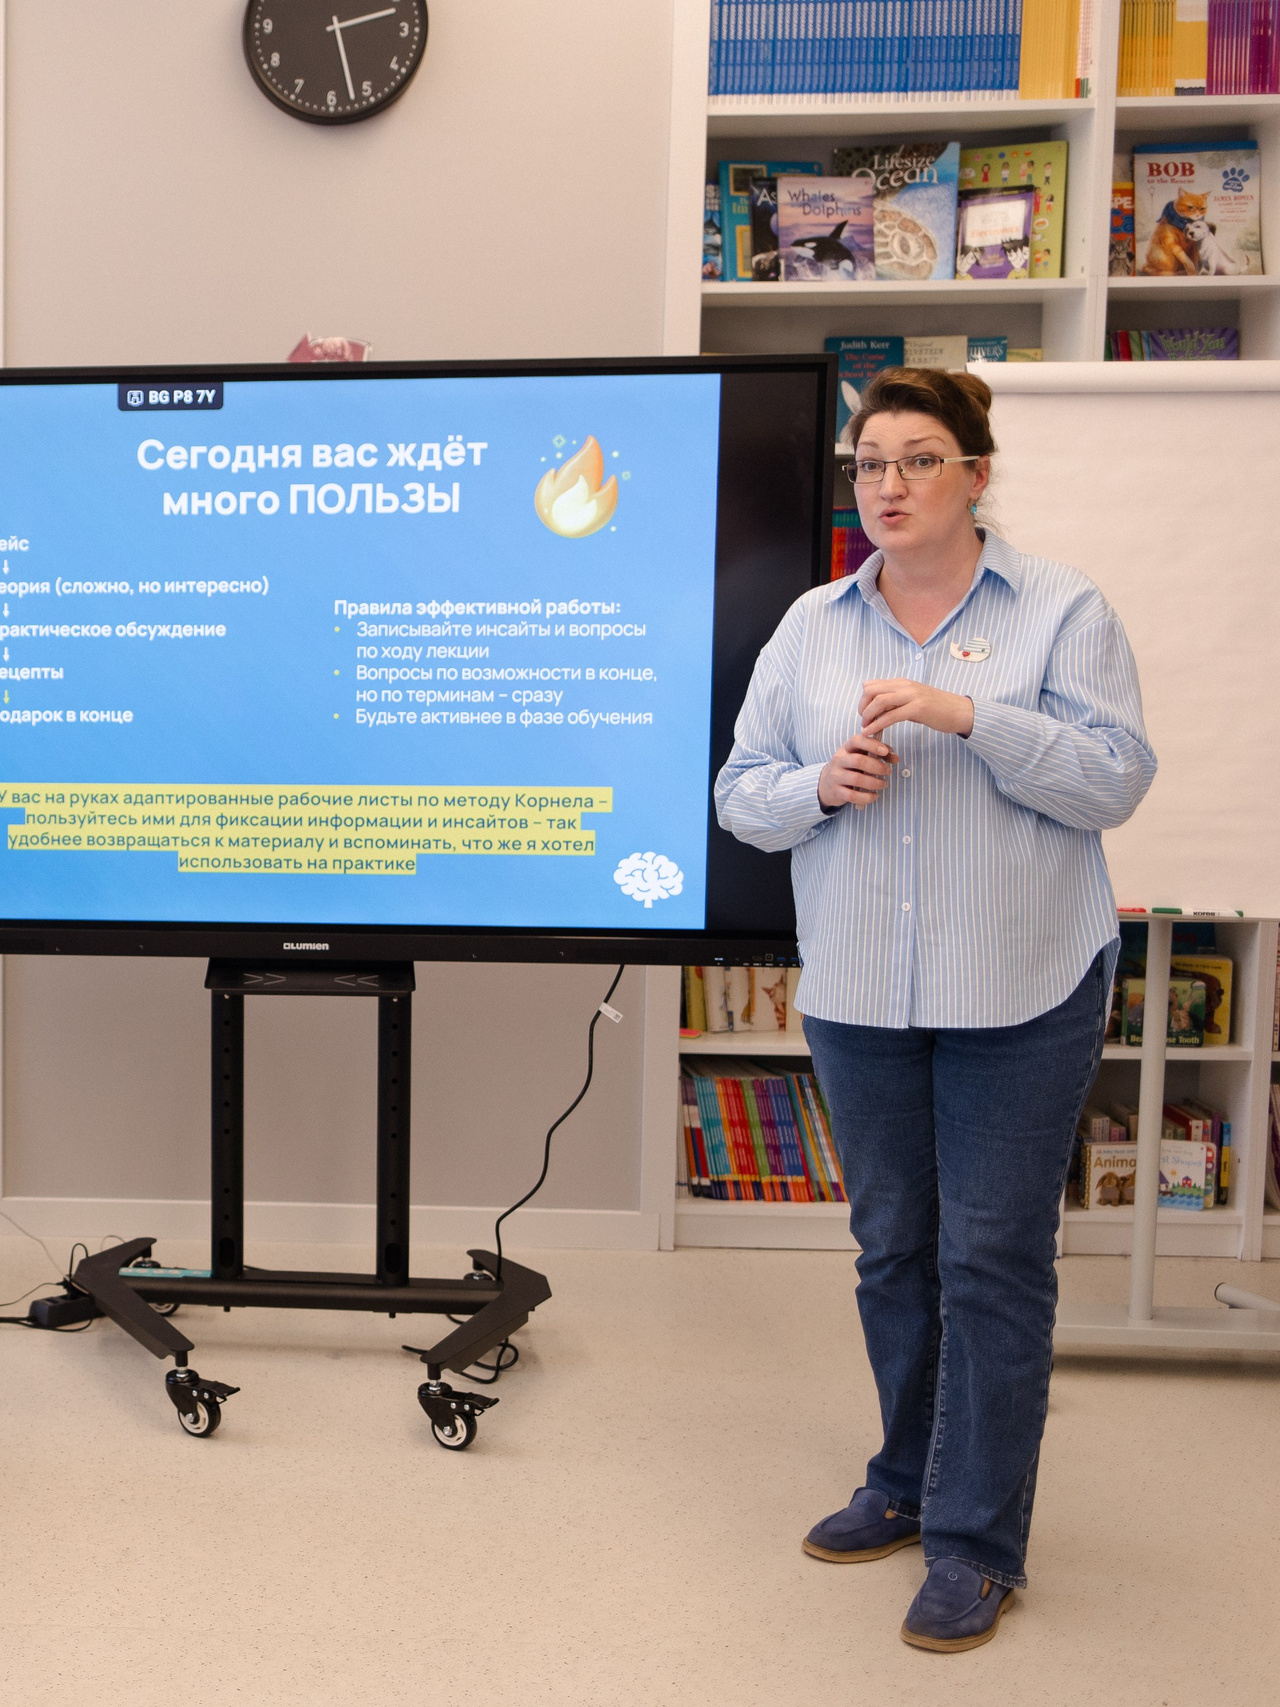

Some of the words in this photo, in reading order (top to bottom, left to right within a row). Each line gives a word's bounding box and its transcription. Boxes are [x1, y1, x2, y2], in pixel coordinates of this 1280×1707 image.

[262, 19, 273, 34] 9
[399, 22, 410, 38] 3
[270, 52, 281, 67] 8
[390, 56, 399, 71] 4
[294, 79, 305, 94] 7
[362, 81, 372, 97] 5
[326, 90, 337, 107] 6
[873, 152, 935, 171] Lifesize
[1147, 162, 1195, 177] BOB
[787, 187, 836, 203] Whales
[802, 202, 862, 219] Dolphins
[840, 340, 867, 350] Judith
[870, 340, 891, 349] Kerr
[148, 389, 170, 404] BG
[173, 389, 193, 404] P8
[195, 389, 216, 403] 7Y
[137, 438, 302, 474] Сегодня
[312, 445, 378, 468] вас
[386, 434, 489, 472] ждёт
[163, 490, 280, 516] много
[289, 482, 460, 515] ПОЛЬЗЫ
[55, 576, 135, 597] (сложно,
[138, 580, 162, 594] но
[164, 575, 269, 598] интересно)
[334, 599, 413, 620] Правила
[416, 598, 542, 619] эффективной
[545, 598, 621, 619] работы:
[114, 621, 227, 641] обсуждение
[356, 620, 473, 638] Записывайте
[475, 620, 551, 637] инсайты
[554, 623, 566, 637] и
[569, 623, 647, 641] вопросы
[356, 645, 379, 659] по
[380, 645, 423, 663] ходу
[425, 645, 490, 660] лекции
[356, 664, 433, 685] Вопросы
[436, 667, 459, 681] по
[461, 667, 582, 681] возможности
[585, 667, 596, 681] в
[599, 667, 657, 682] конце,
[356, 689, 378, 703] но
[381, 689, 403, 703] по
[405, 689, 495, 707] терминам
[511, 689, 564, 707] сразу
[66, 710, 77, 723] в
[79, 710, 134, 725] конце
[355, 708, 418, 728] Будьте
[420, 711, 503, 725] активнее
[506, 711, 517, 725] в
[519, 708, 565, 728] фазе
[567, 708, 654, 729] обучения
[11, 792, 41, 804] вас
[45, 792, 65, 804] на
[69, 793, 119, 808] руках
[123, 793, 274, 809] адаптированные
[278, 791, 354, 810] рабочие
[357, 795, 413, 807] листы
[417, 795, 440, 807] по
[443, 795, 511, 812] методу
[515, 793, 594, 812] Корнела
[24, 810, 138, 829] пользуйтесь
[141, 814, 175, 826] ими
[179, 814, 211, 828] для
[215, 812, 303, 830] фиксации
[307, 813, 423, 832] информации
[427, 817, 438, 828] и
[442, 814, 529, 830] инсайтов
[546, 818, 577, 830] так
[7, 831, 83, 849] удобнее
[86, 835, 211, 850] возвращаться
[215, 836, 224, 847] к
[228, 836, 325, 853] материалу
[328, 837, 339, 849] и
[343, 837, 456, 855] вспоминать,
[461, 839, 493, 851] что
[497, 839, 522, 851] же
[526, 839, 537, 851] я
[541, 839, 595, 852] хотел
[179, 857, 303, 871] использовать
[307, 858, 328, 870] на
[331, 858, 416, 875] практике
[1166, 1035, 1176, 1044] ose
[1178, 1035, 1200, 1044] Tooth
[1093, 1155, 1137, 1169] Anima
